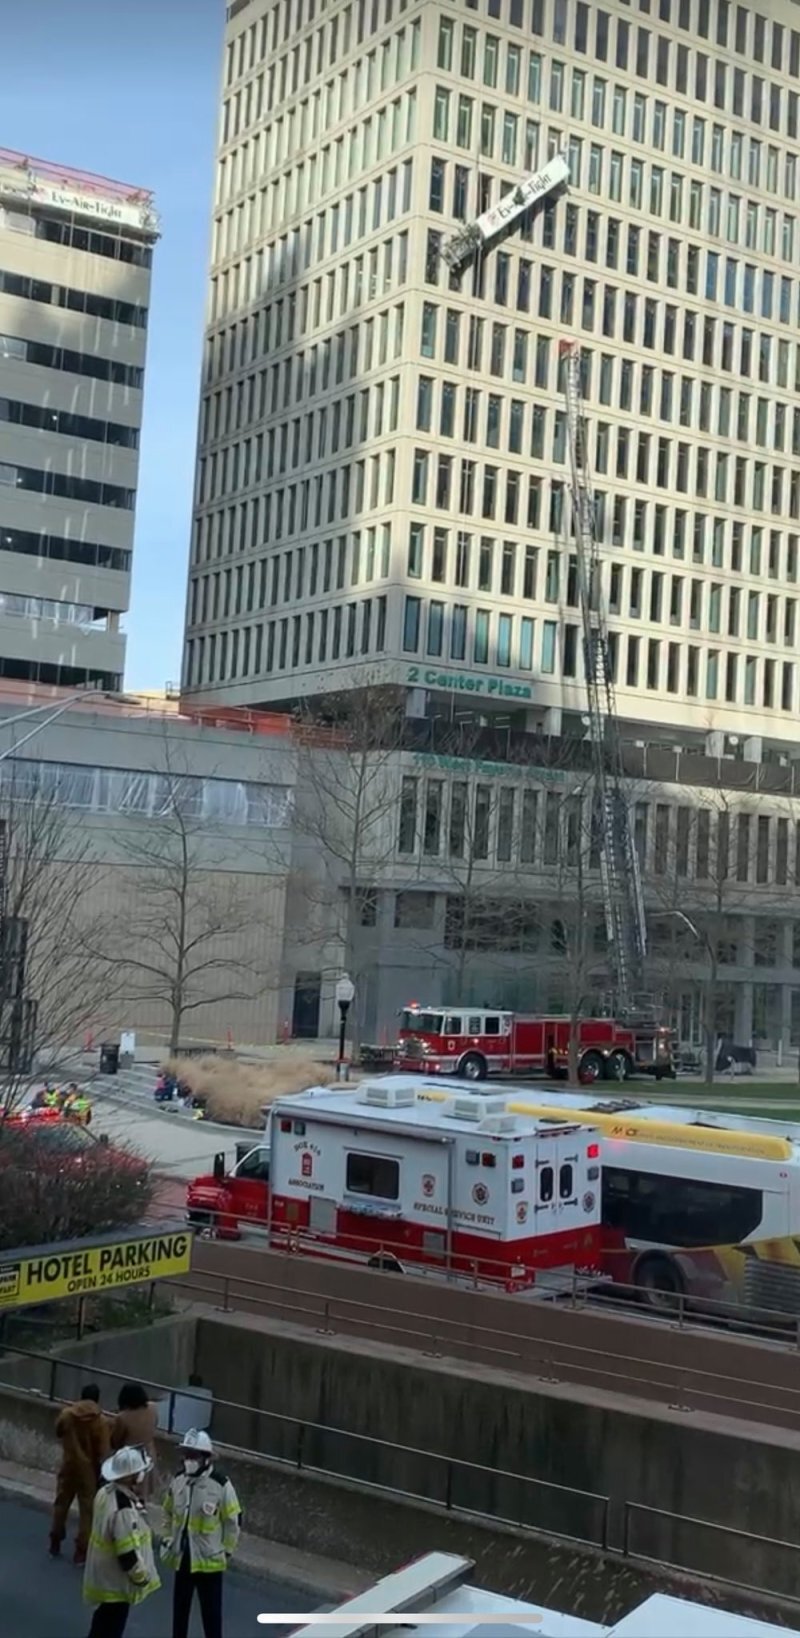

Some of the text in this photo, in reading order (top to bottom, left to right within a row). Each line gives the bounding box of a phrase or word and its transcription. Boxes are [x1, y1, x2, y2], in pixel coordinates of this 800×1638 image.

[407, 667, 532, 698] 2 Center Plaza
[444, 1207, 476, 1222] SRVICE
[476, 1214, 496, 1225] UNIT
[27, 1236, 187, 1285] HOTEL PARKING
[67, 1266, 150, 1292] OPEN 24 HOURS
